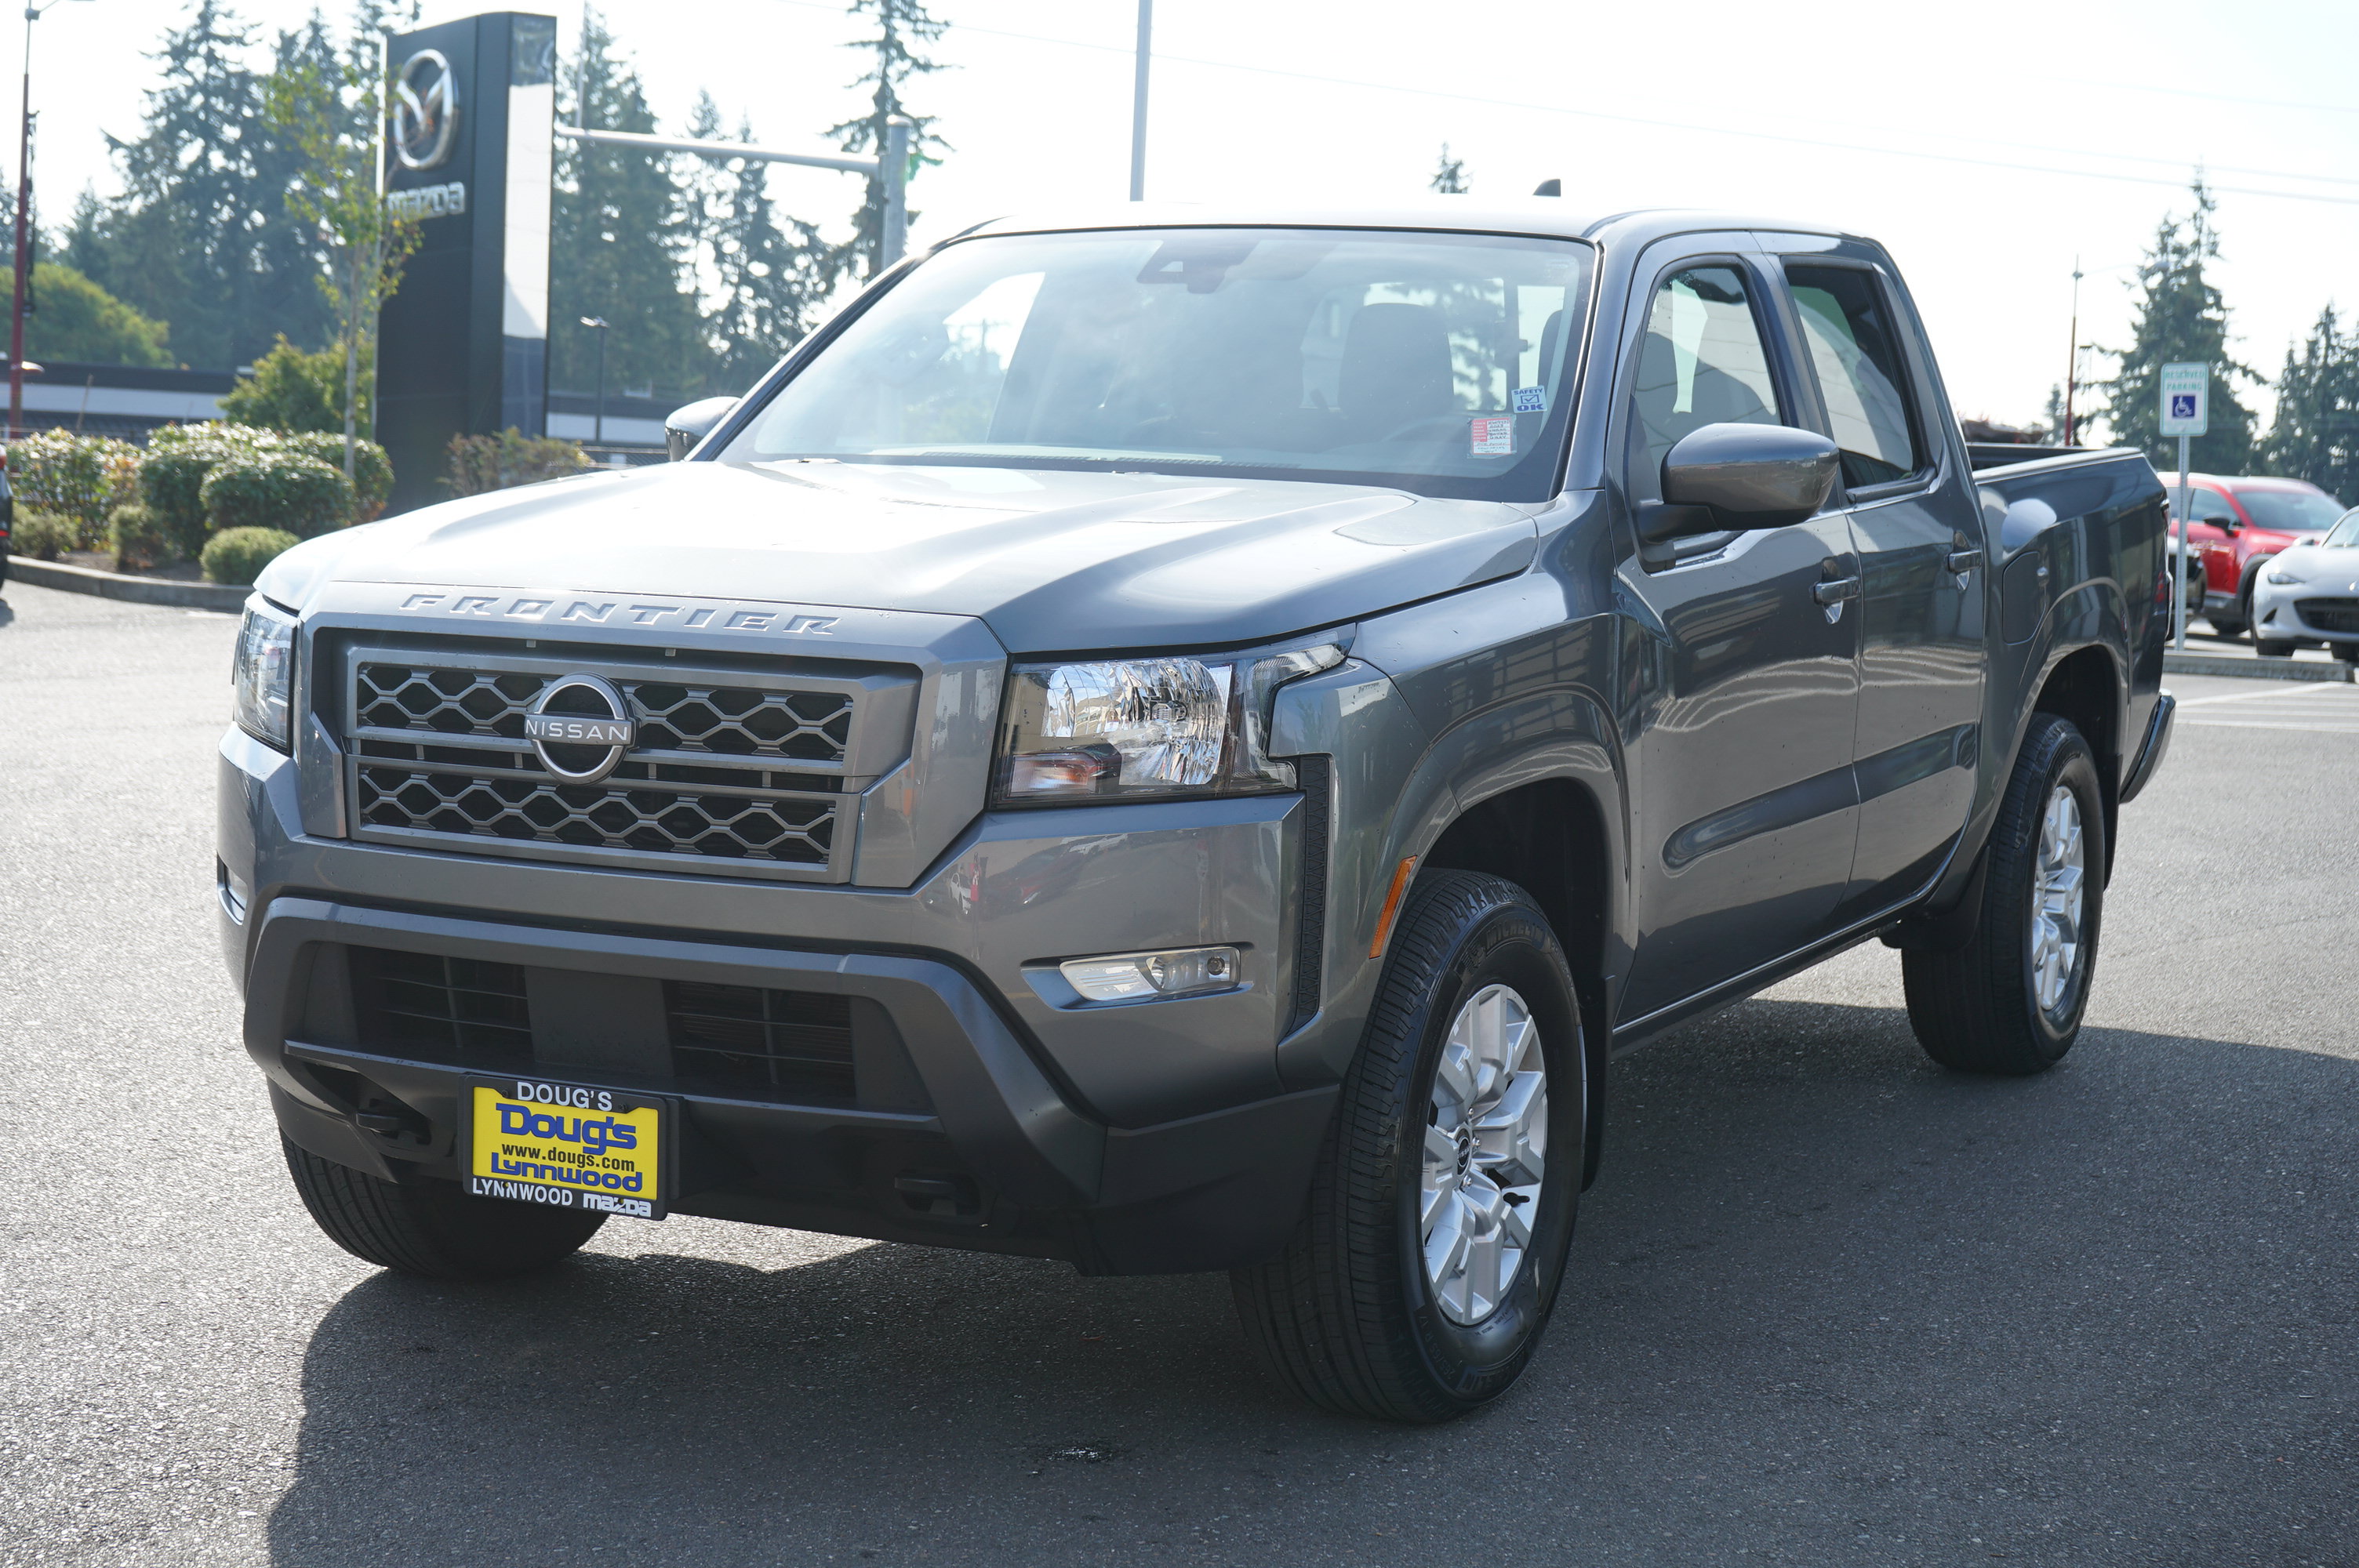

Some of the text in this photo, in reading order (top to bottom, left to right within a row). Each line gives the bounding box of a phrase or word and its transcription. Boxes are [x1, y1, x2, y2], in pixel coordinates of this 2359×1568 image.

[2165, 369, 2205, 379] RESERVED
[2167, 381, 2203, 390] PARKING
[396, 593, 841, 636] FRONTIER
[525, 718, 628, 742] NISSAN
[517, 1081, 612, 1112] DOUG'S
[496, 1102, 637, 1156] Doug's
[491, 1152, 642, 1192] Lynnwood
[502, 1144, 635, 1172] www.dougs.com
[472, 1178, 572, 1206] LYNNWOOD
